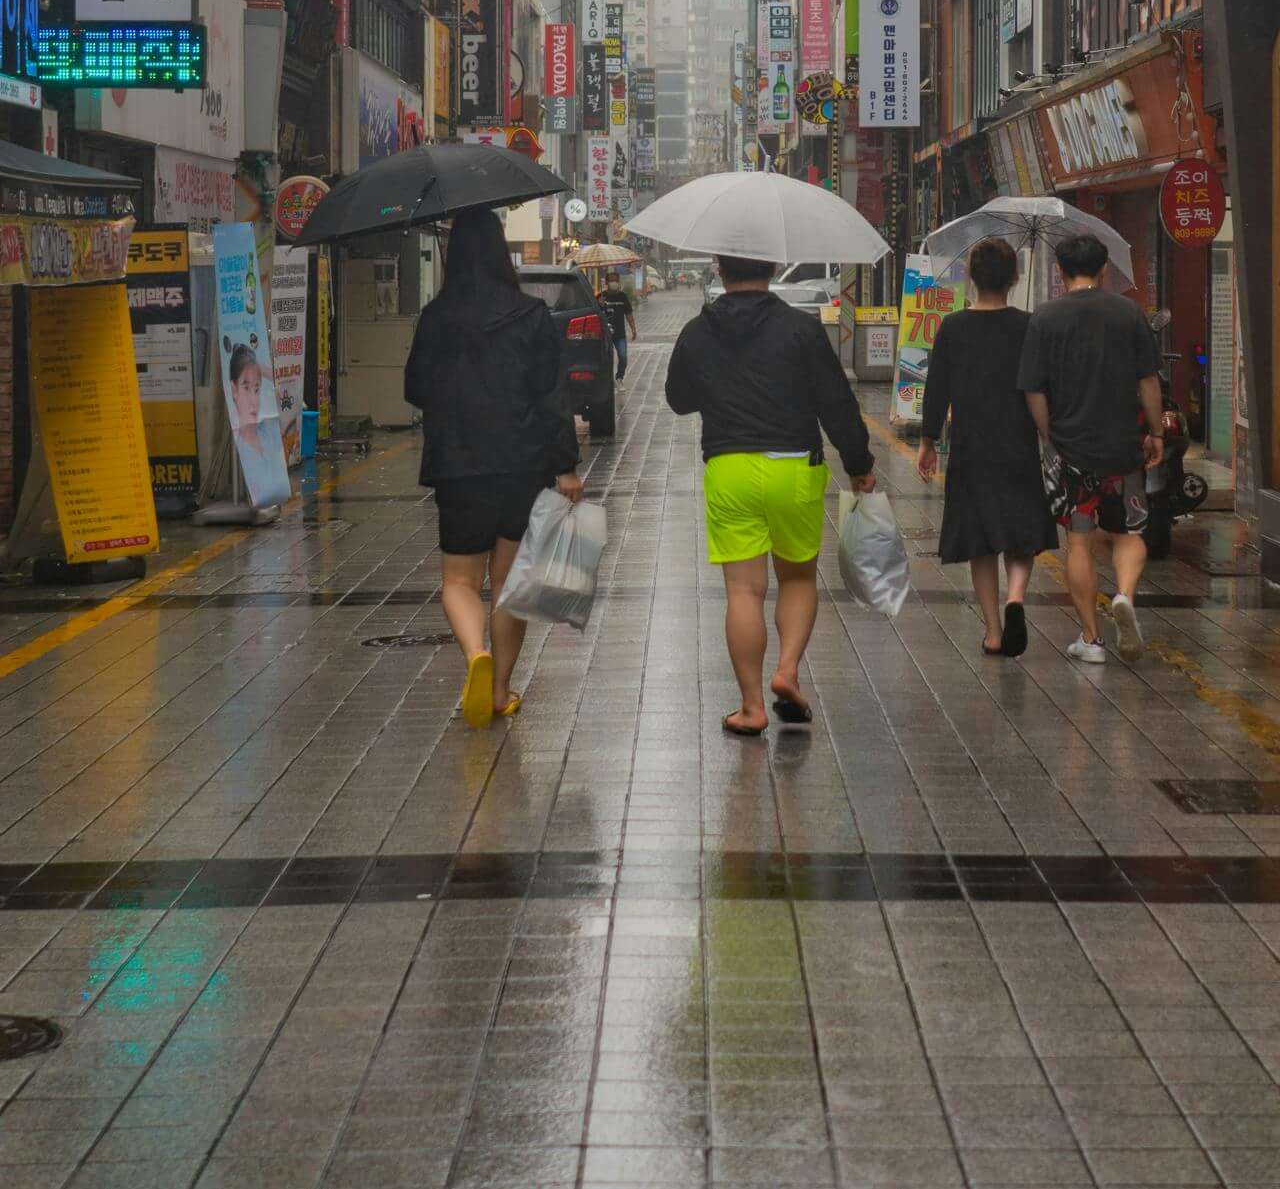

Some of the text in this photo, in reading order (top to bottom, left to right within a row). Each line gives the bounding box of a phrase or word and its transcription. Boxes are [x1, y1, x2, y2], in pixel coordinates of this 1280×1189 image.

[553, 32, 568, 95] PAGODA
[1173, 170, 1209, 185] 조이
[1175, 188, 1211, 204] 치즈
[1175, 207, 1213, 225] 등짝
